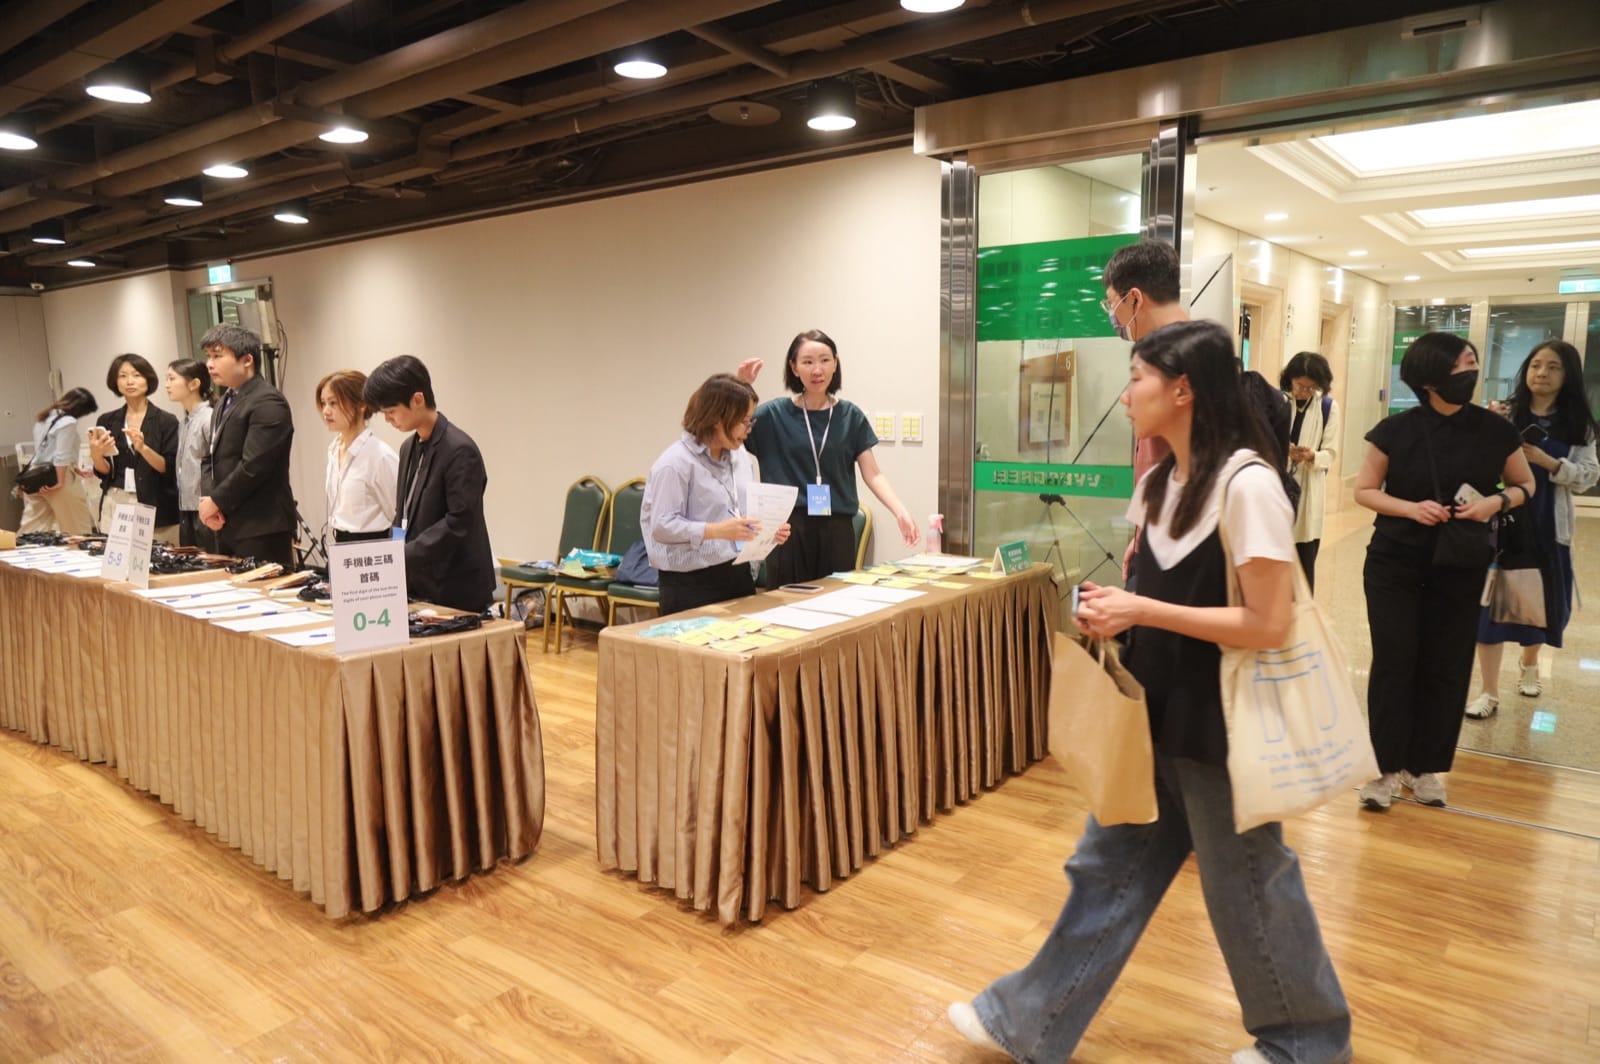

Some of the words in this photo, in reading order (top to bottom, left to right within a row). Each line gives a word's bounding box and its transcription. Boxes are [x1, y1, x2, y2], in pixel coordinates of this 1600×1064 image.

[343, 554, 393, 568] 手機後三碼
[360, 572, 379, 583] 首碼
[353, 608, 391, 632] 0-4
